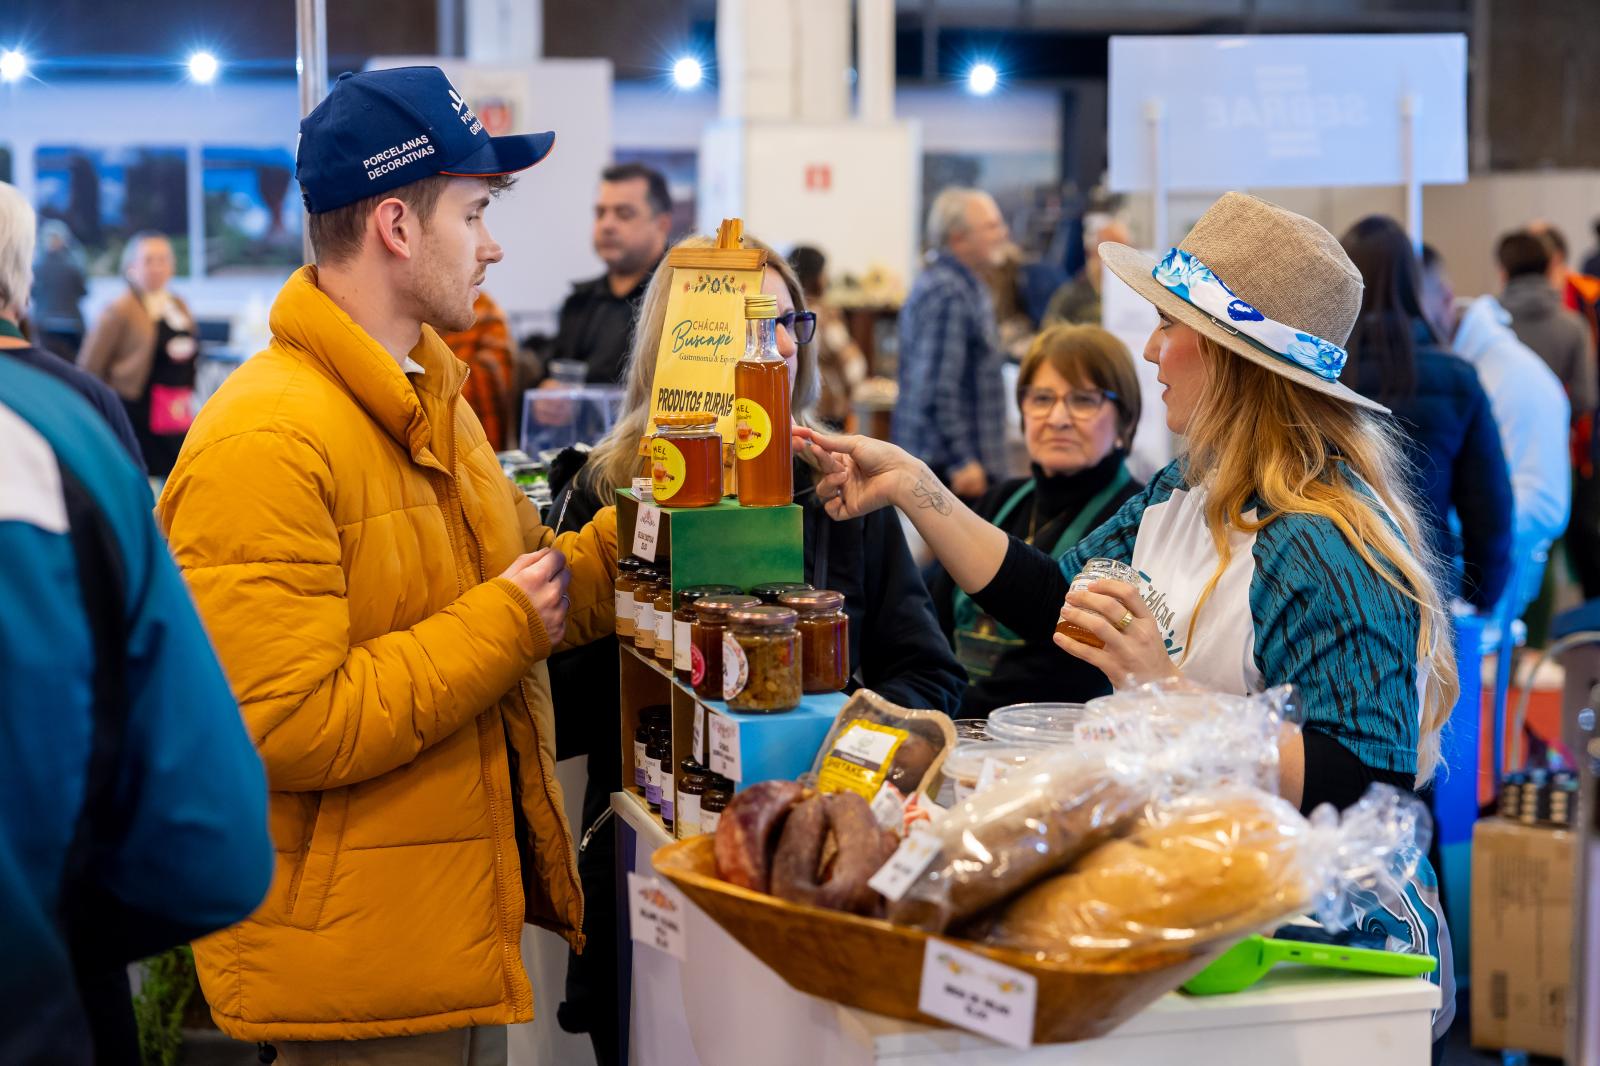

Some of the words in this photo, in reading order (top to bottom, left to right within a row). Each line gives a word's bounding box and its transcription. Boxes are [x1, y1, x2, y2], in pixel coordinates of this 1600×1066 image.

[363, 134, 429, 169] PORCELANAS
[367, 145, 435, 180] DECORATIVAS
[671, 319, 734, 356] Buscapé
[692, 317, 730, 332] CHÁCARA
[657, 387, 703, 413] PRODUTOS
[702, 391, 735, 417] RURAIS
